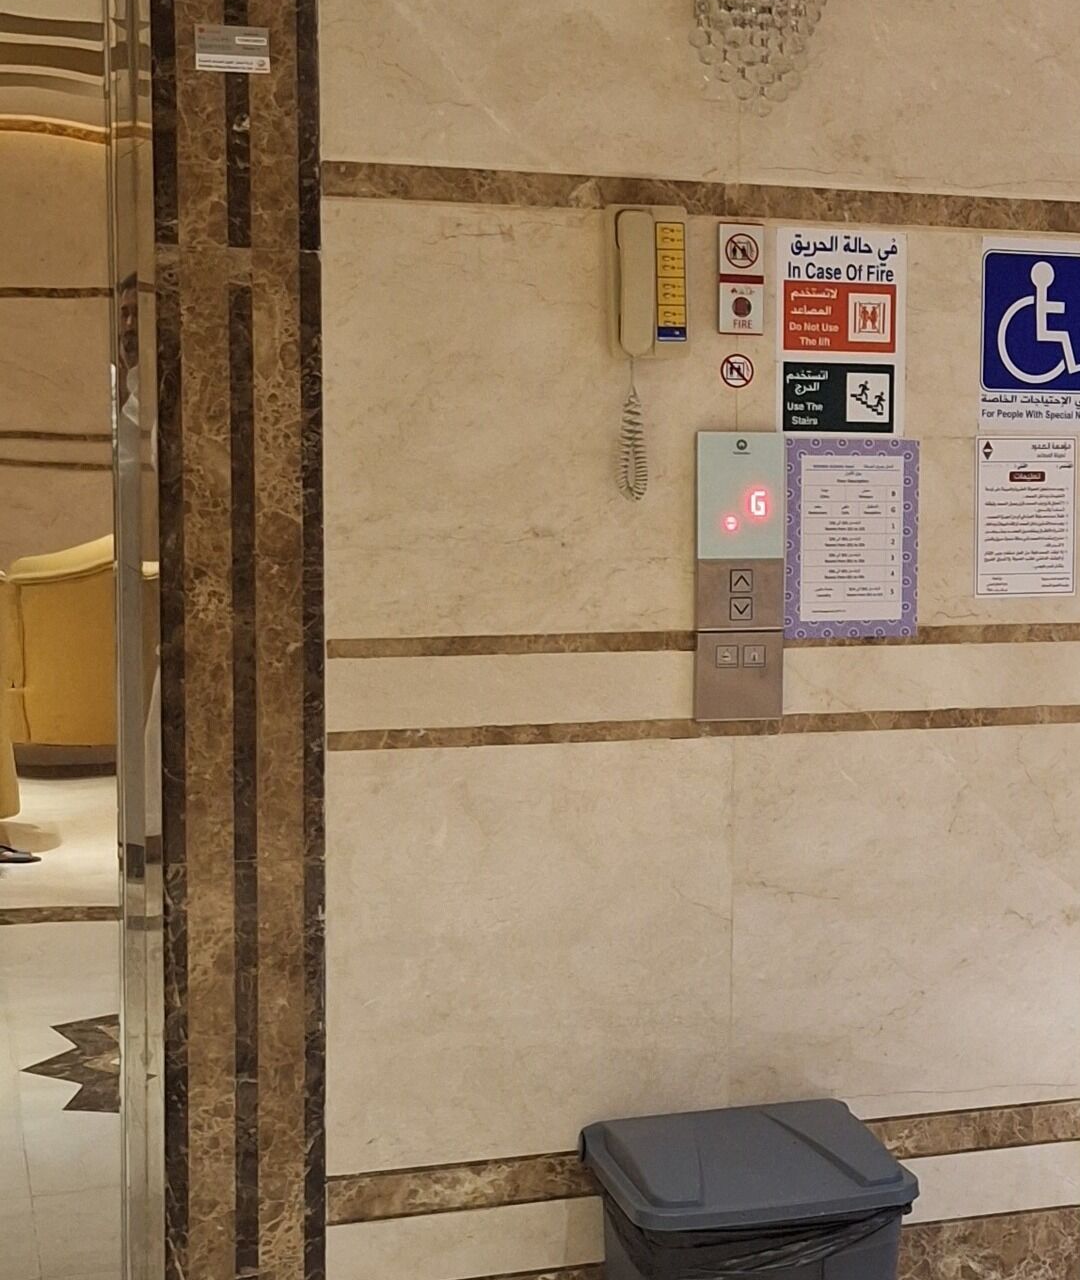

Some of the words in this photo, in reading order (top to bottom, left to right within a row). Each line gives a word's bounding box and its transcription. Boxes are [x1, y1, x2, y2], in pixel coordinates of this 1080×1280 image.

[790, 233, 838, 258] الحريق
[842, 235, 873, 254] حالة
[877, 237, 898, 267] في
[787, 261, 801, 279] In
[805, 262, 842, 280] Case
[846, 264, 864, 282] Of
[866, 264, 894, 282] Fire
[790, 304, 832, 316] المصاعد
[733, 319, 753, 330] FIRE
[789, 321, 803, 332] Do
[803, 322, 821, 333] Not
[821, 322, 840, 333] Use
[799, 336, 817, 347] The
[794, 381, 820, 396] الدرج
[981, 393, 1018, 404] الخاصة
[786, 401, 805, 412] Use
[806, 401, 824, 412] The
[981, 408, 996, 418] For
[997, 409, 1024, 420] People
[1025, 409, 1043, 419] With
[1045, 410, 1074, 420] Special
[791, 415, 819, 426] Stairs
[750, 490, 767, 517] G
